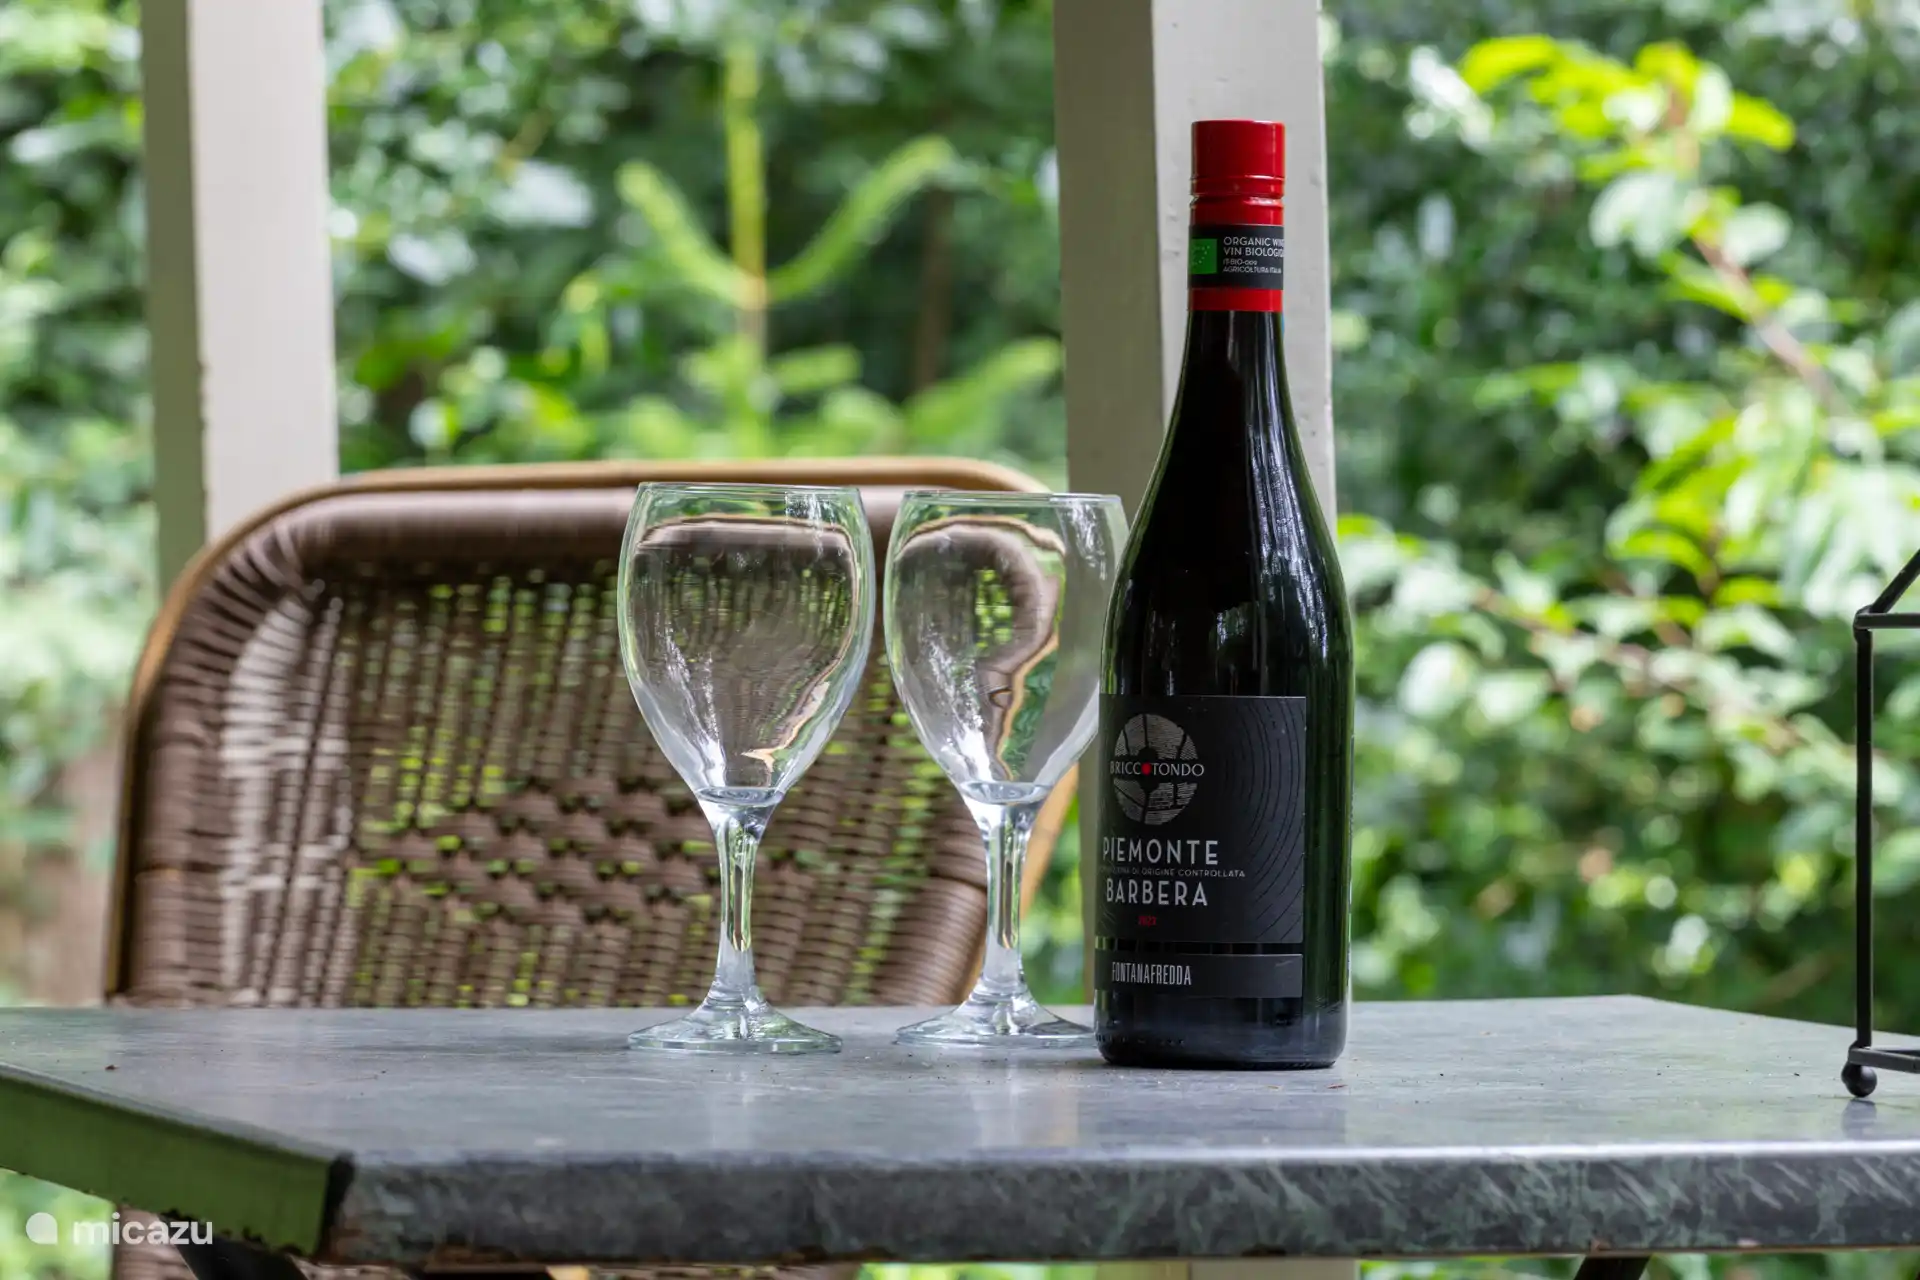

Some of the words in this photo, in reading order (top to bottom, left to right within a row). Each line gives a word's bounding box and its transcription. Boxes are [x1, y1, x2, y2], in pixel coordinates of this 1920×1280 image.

[1223, 236, 1271, 247] ORGANIC
[1223, 246, 1242, 256] VIN
[1102, 836, 1219, 865] PIEMONTE
[1141, 867, 1175, 877] ORIGINE
[1177, 868, 1246, 878] CONTROLLATA
[1106, 878, 1209, 907] BARBERA
[1111, 961, 1192, 986] FONTANAFREDDA
